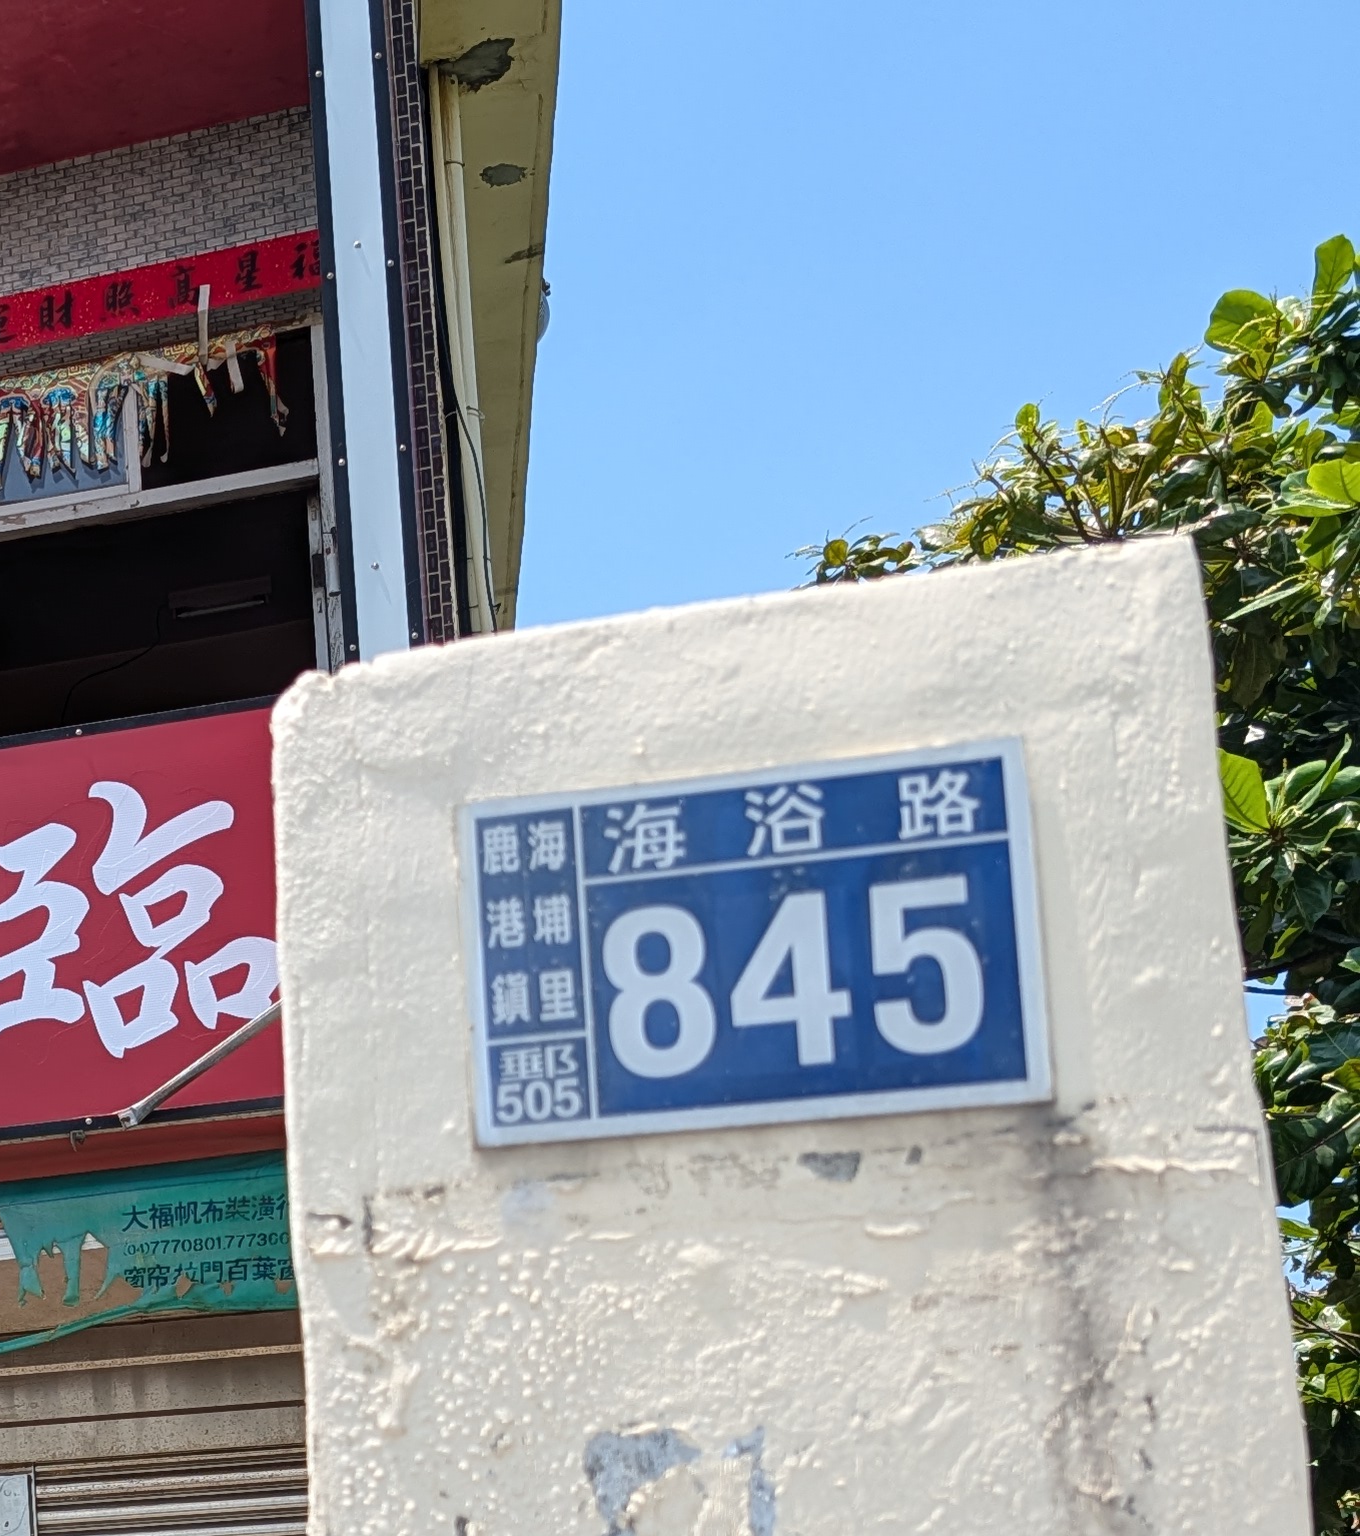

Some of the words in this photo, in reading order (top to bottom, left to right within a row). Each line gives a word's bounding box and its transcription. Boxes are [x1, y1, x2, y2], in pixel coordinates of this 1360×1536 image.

[528, 820, 578, 1022] 海埔里
[603, 769, 979, 875] 海浴路
[482, 824, 532, 1024] 鹿港鎮
[601, 873, 984, 1079] 845
[495, 1080, 580, 1123] 505
